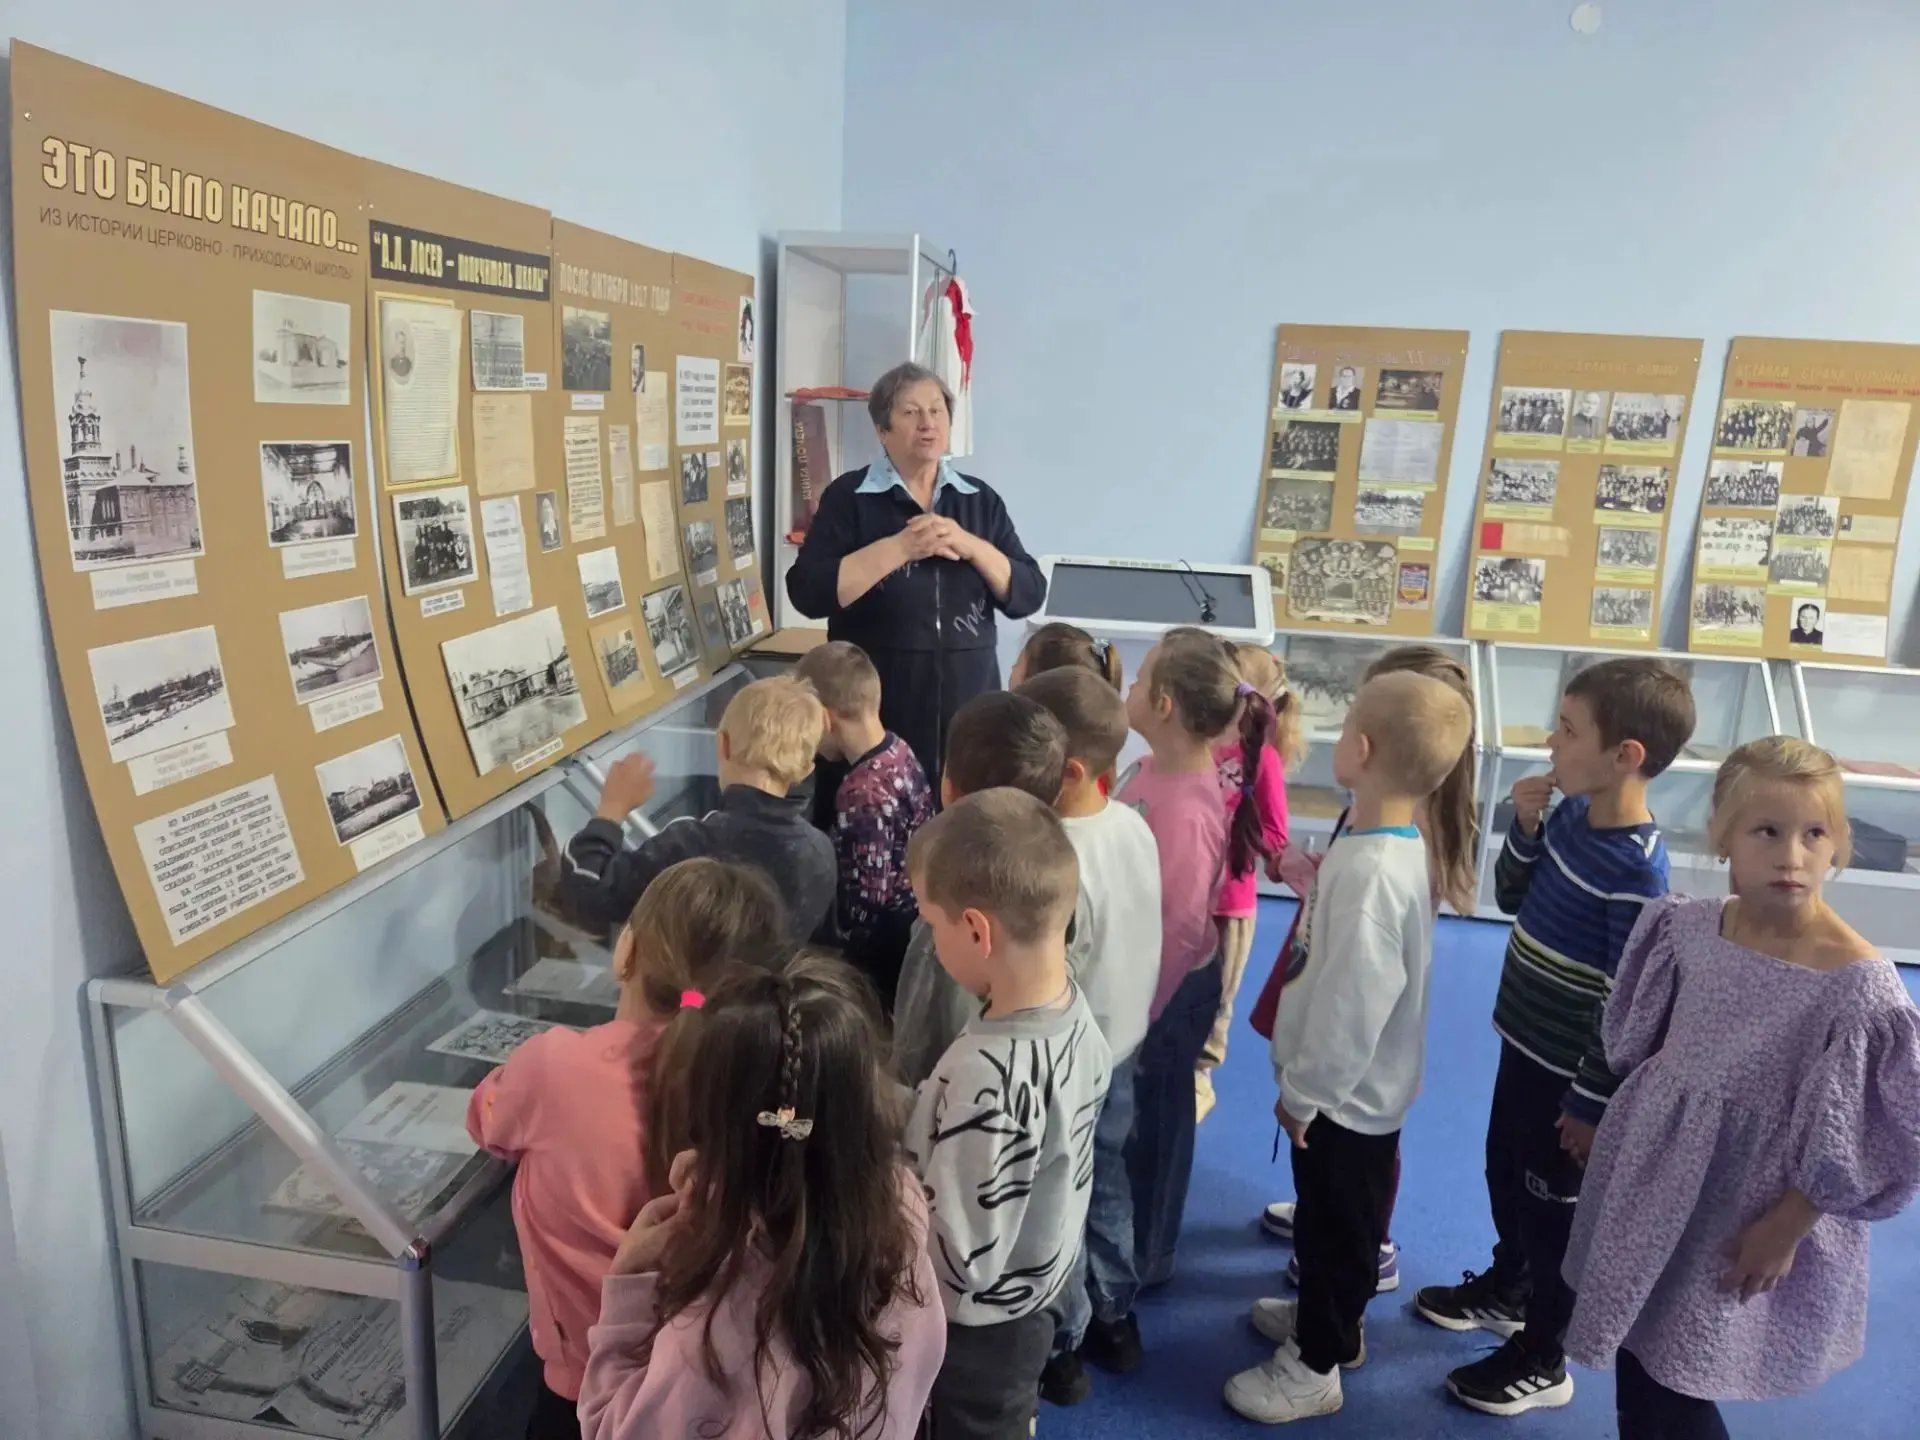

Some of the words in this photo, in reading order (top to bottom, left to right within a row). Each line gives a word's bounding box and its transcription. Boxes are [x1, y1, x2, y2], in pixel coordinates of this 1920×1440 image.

[39, 206, 62, 226] ИЗ
[67, 211, 143, 242] ИСТОРИИ
[147, 229, 223, 256] ЦЕРКОВНО
[233, 243, 312, 275] ПРИХОДСКОЙ
[41, 136, 117, 200] ЭТО
[125, 156, 224, 224] БЫЛО
[230, 184, 359, 255] НАЧАЛО...
